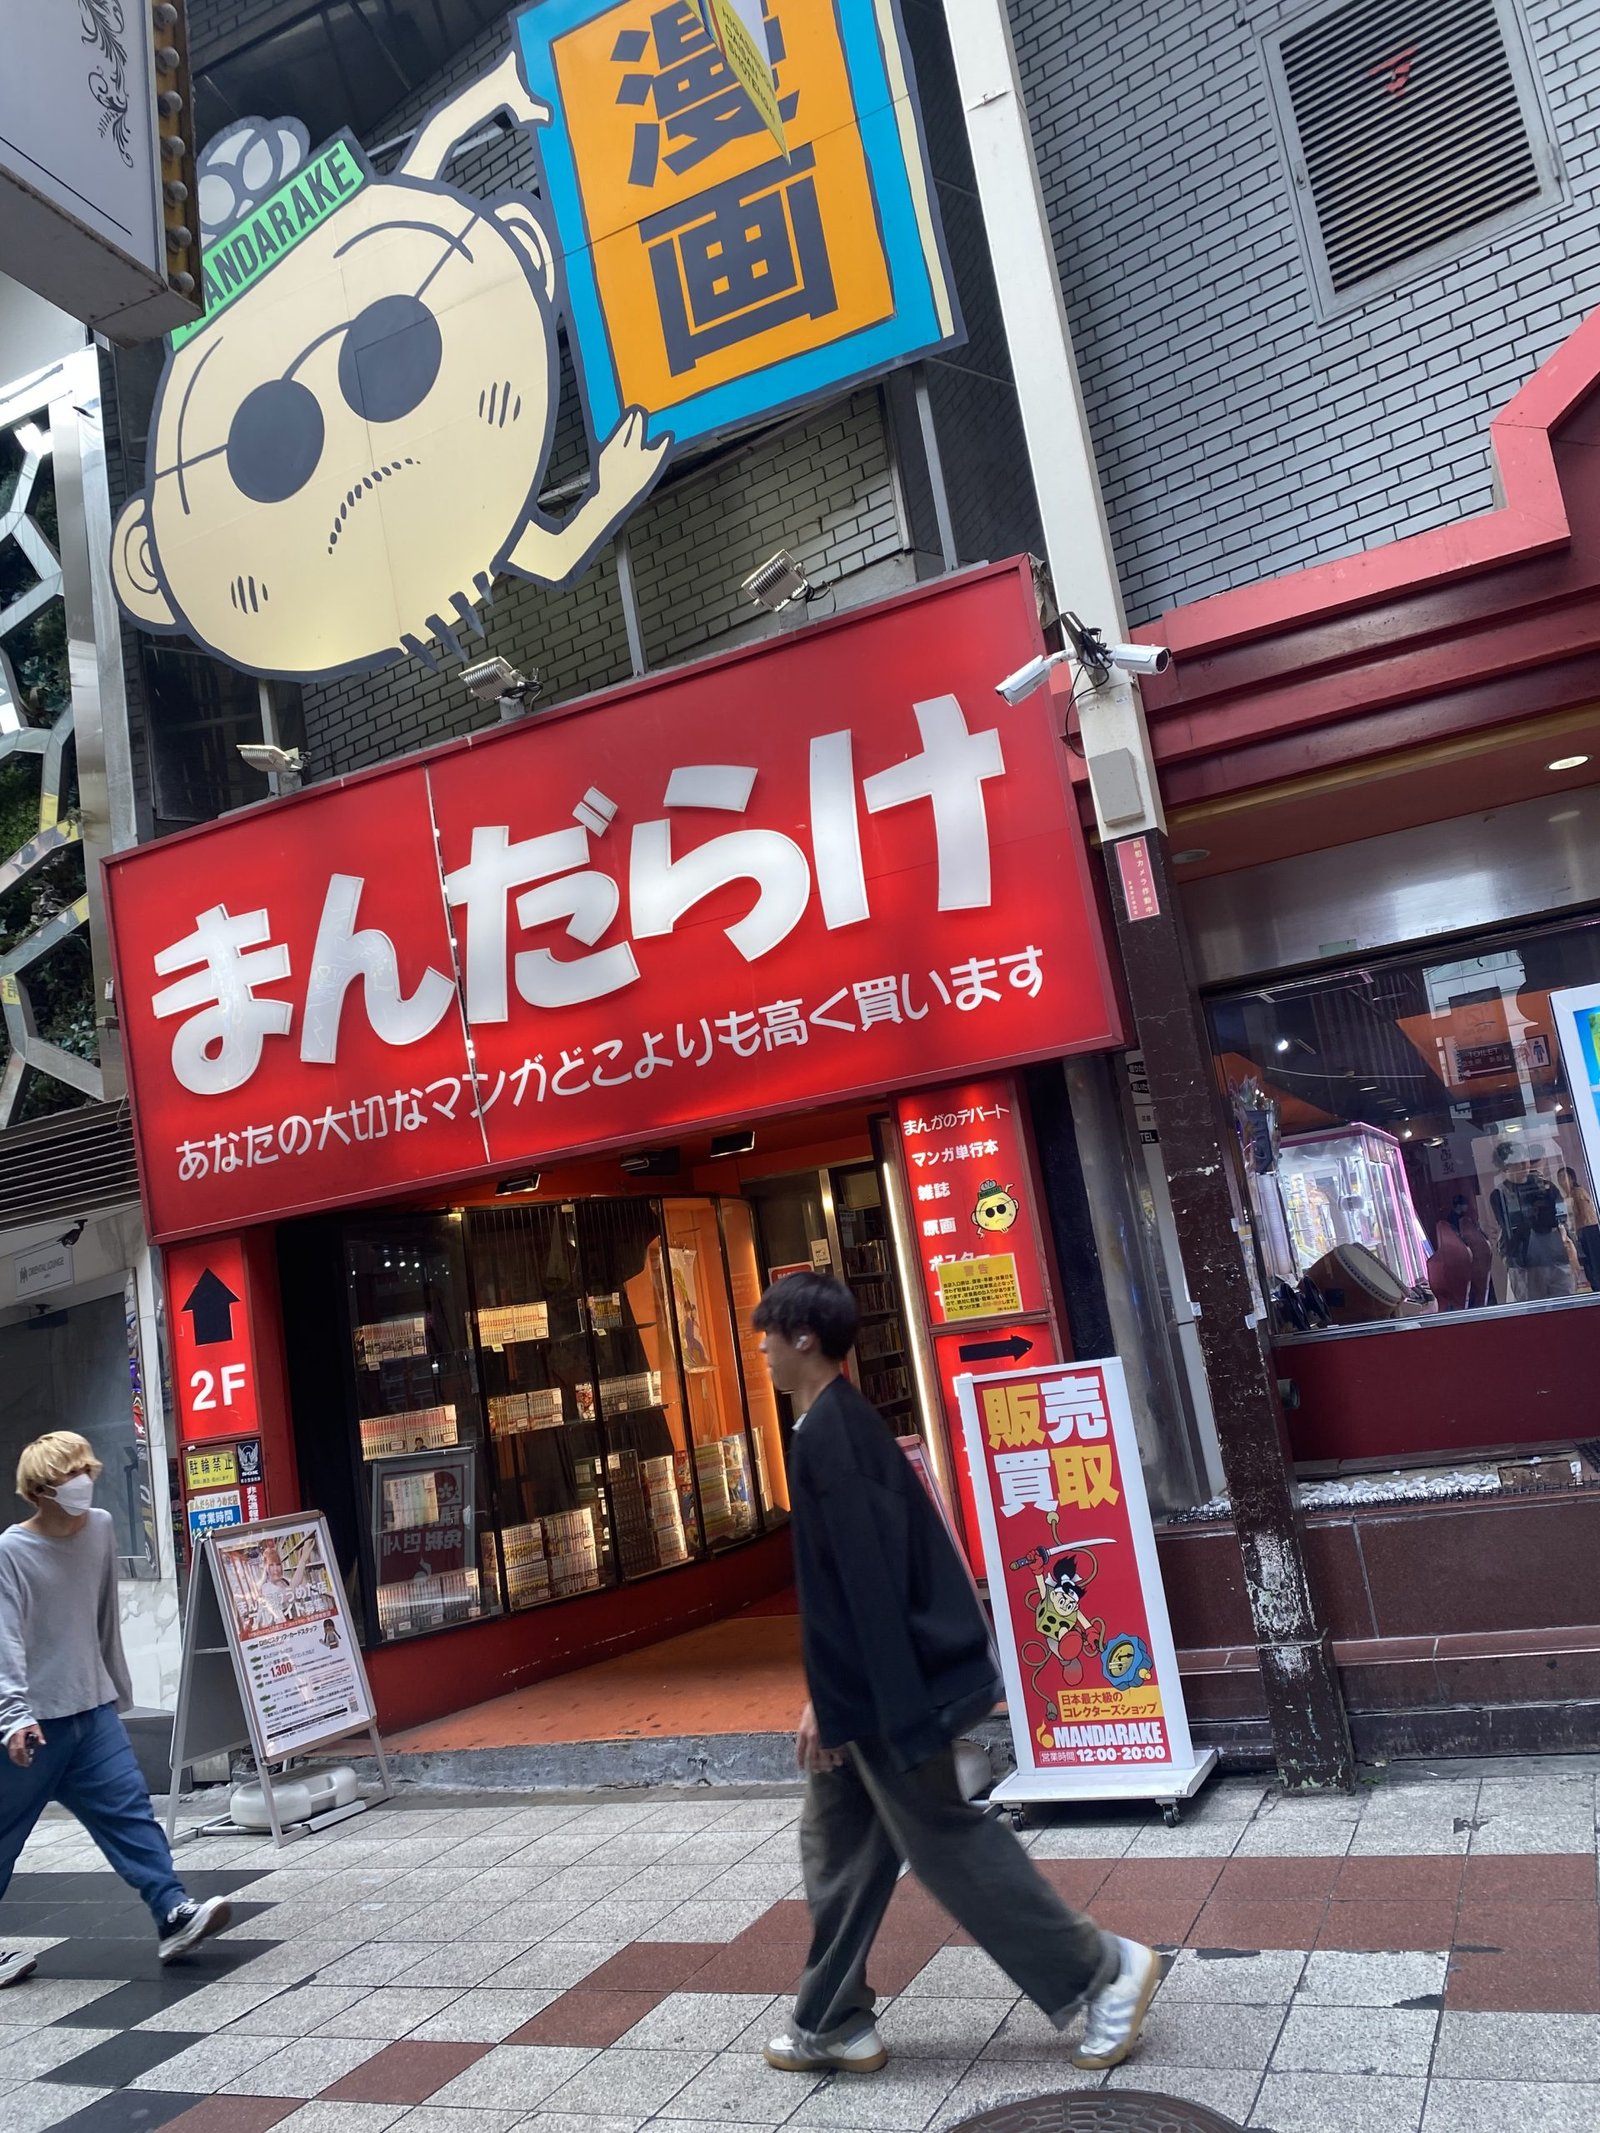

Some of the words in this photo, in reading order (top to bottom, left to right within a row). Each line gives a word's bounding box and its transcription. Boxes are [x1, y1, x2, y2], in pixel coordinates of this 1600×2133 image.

[608, 0, 838, 377] 漫画
[184, 146, 355, 331] ANDARAKE
[152, 693, 1006, 1095] まんだらけ
[176, 946, 1045, 1182] あなたの大切なマンガどこよりも高く買います
[912, 1139, 999, 1167] マンガ単行本
[917, 1182, 951, 1201] 雑誌
[923, 1217, 957, 1237] 原画
[190, 1363, 246, 1411] 2F
[982, 1376, 1108, 1450] 販売
[189, 1455, 234, 1476] 駐輪禁止
[993, 1444, 1120, 1518] 買取
[198, 1509, 234, 1526] 営業時間
[1061, 1691, 1122, 1706] 日本最大級の
[1063, 1702, 1157, 1718] コレクターズショップ
[1053, 1721, 1163, 1749] MANDARAKE
[1041, 1751, 1076, 1763] 営業時間
[1077, 1746, 1166, 1762] 12:00-20:00
